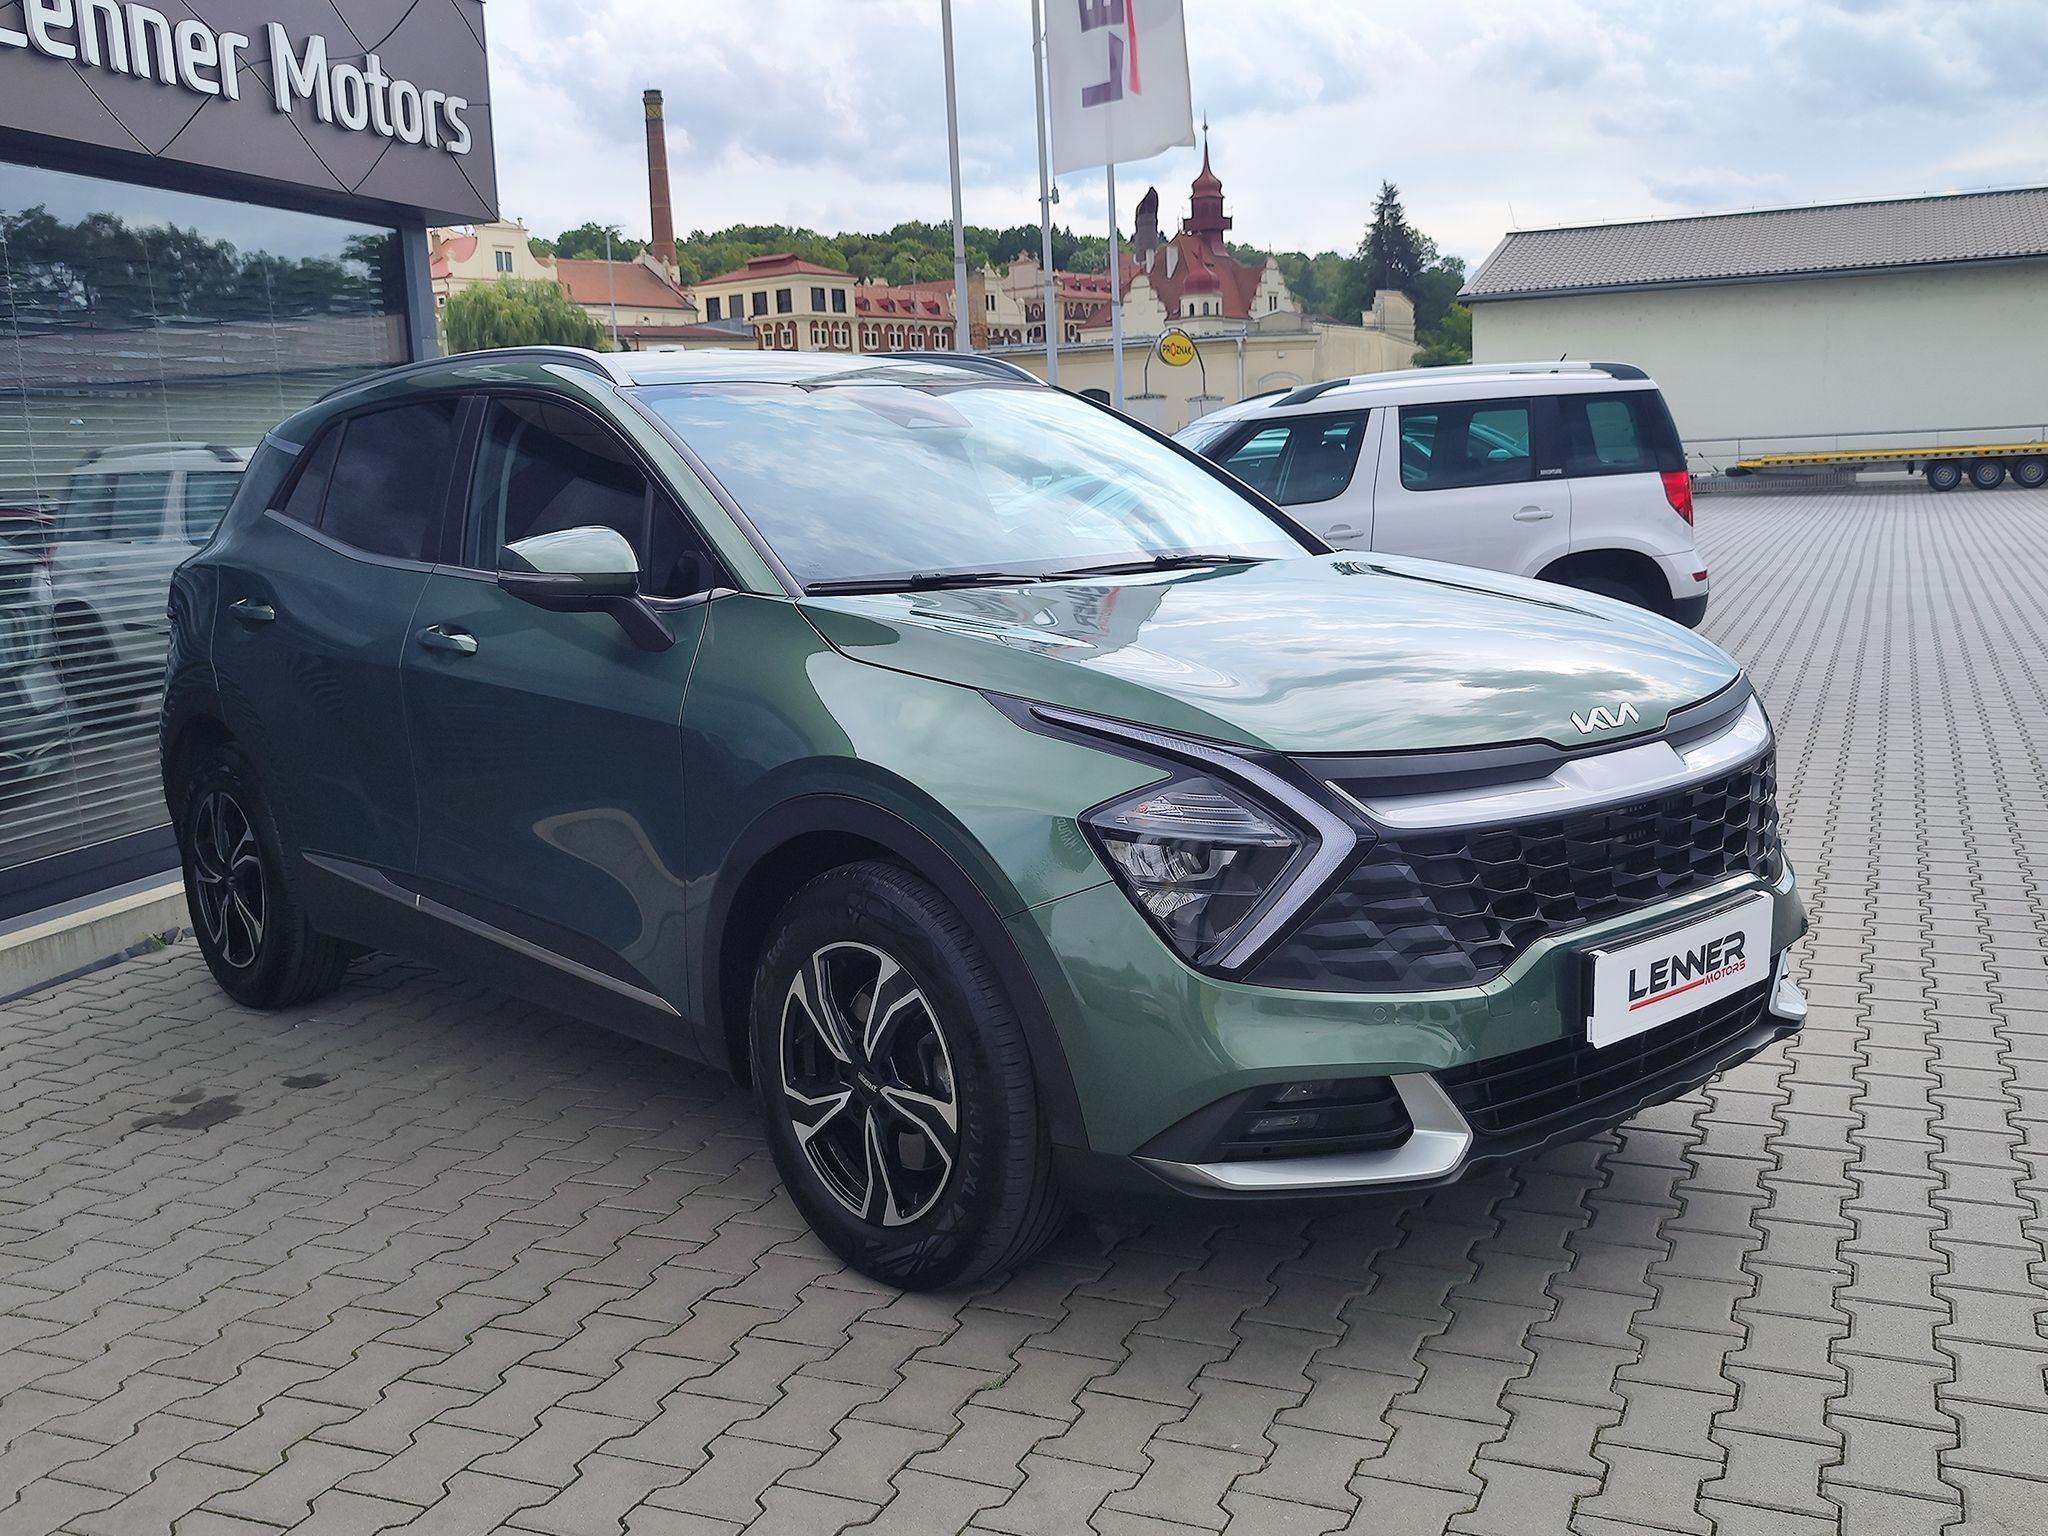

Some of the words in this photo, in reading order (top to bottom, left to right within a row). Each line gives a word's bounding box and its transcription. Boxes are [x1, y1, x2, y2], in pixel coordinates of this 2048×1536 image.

[0, 0, 249, 101] enner
[267, 22, 472, 155] Motors
[1629, 931, 1746, 1002] LENNER
[1705, 960, 1746, 985] MOTORS
